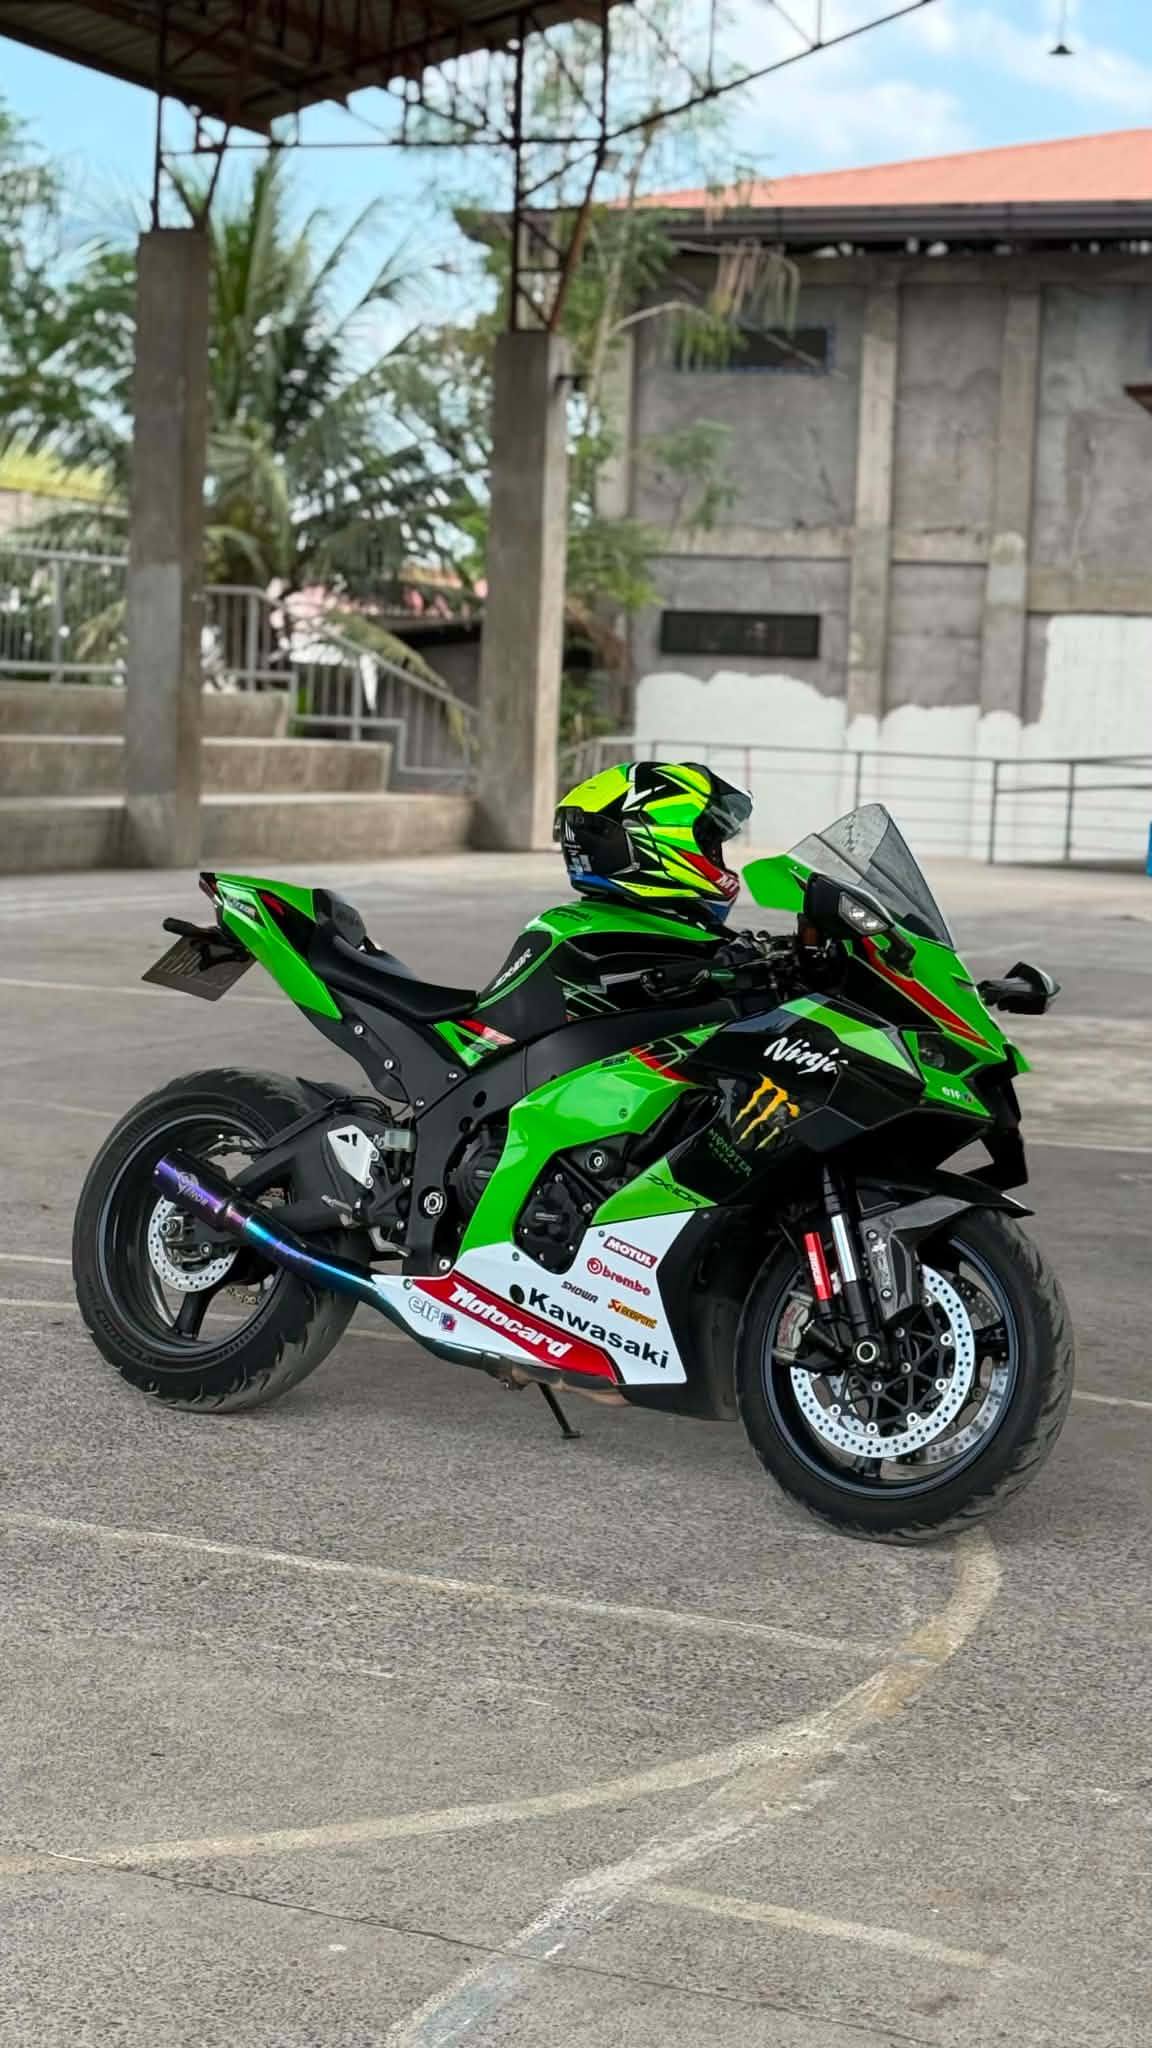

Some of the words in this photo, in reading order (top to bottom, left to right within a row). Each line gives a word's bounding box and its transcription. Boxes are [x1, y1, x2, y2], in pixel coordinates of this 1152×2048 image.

[763, 1037, 848, 1075] Ninja
[605, 1238, 656, 1267] MOTUL
[560, 1280, 599, 1304] SHOWA
[602, 1265, 651, 1297] brembo
[408, 1295, 440, 1323] elf
[449, 1281, 572, 1358] Motocard
[528, 1287, 669, 1369] Kawasaki
